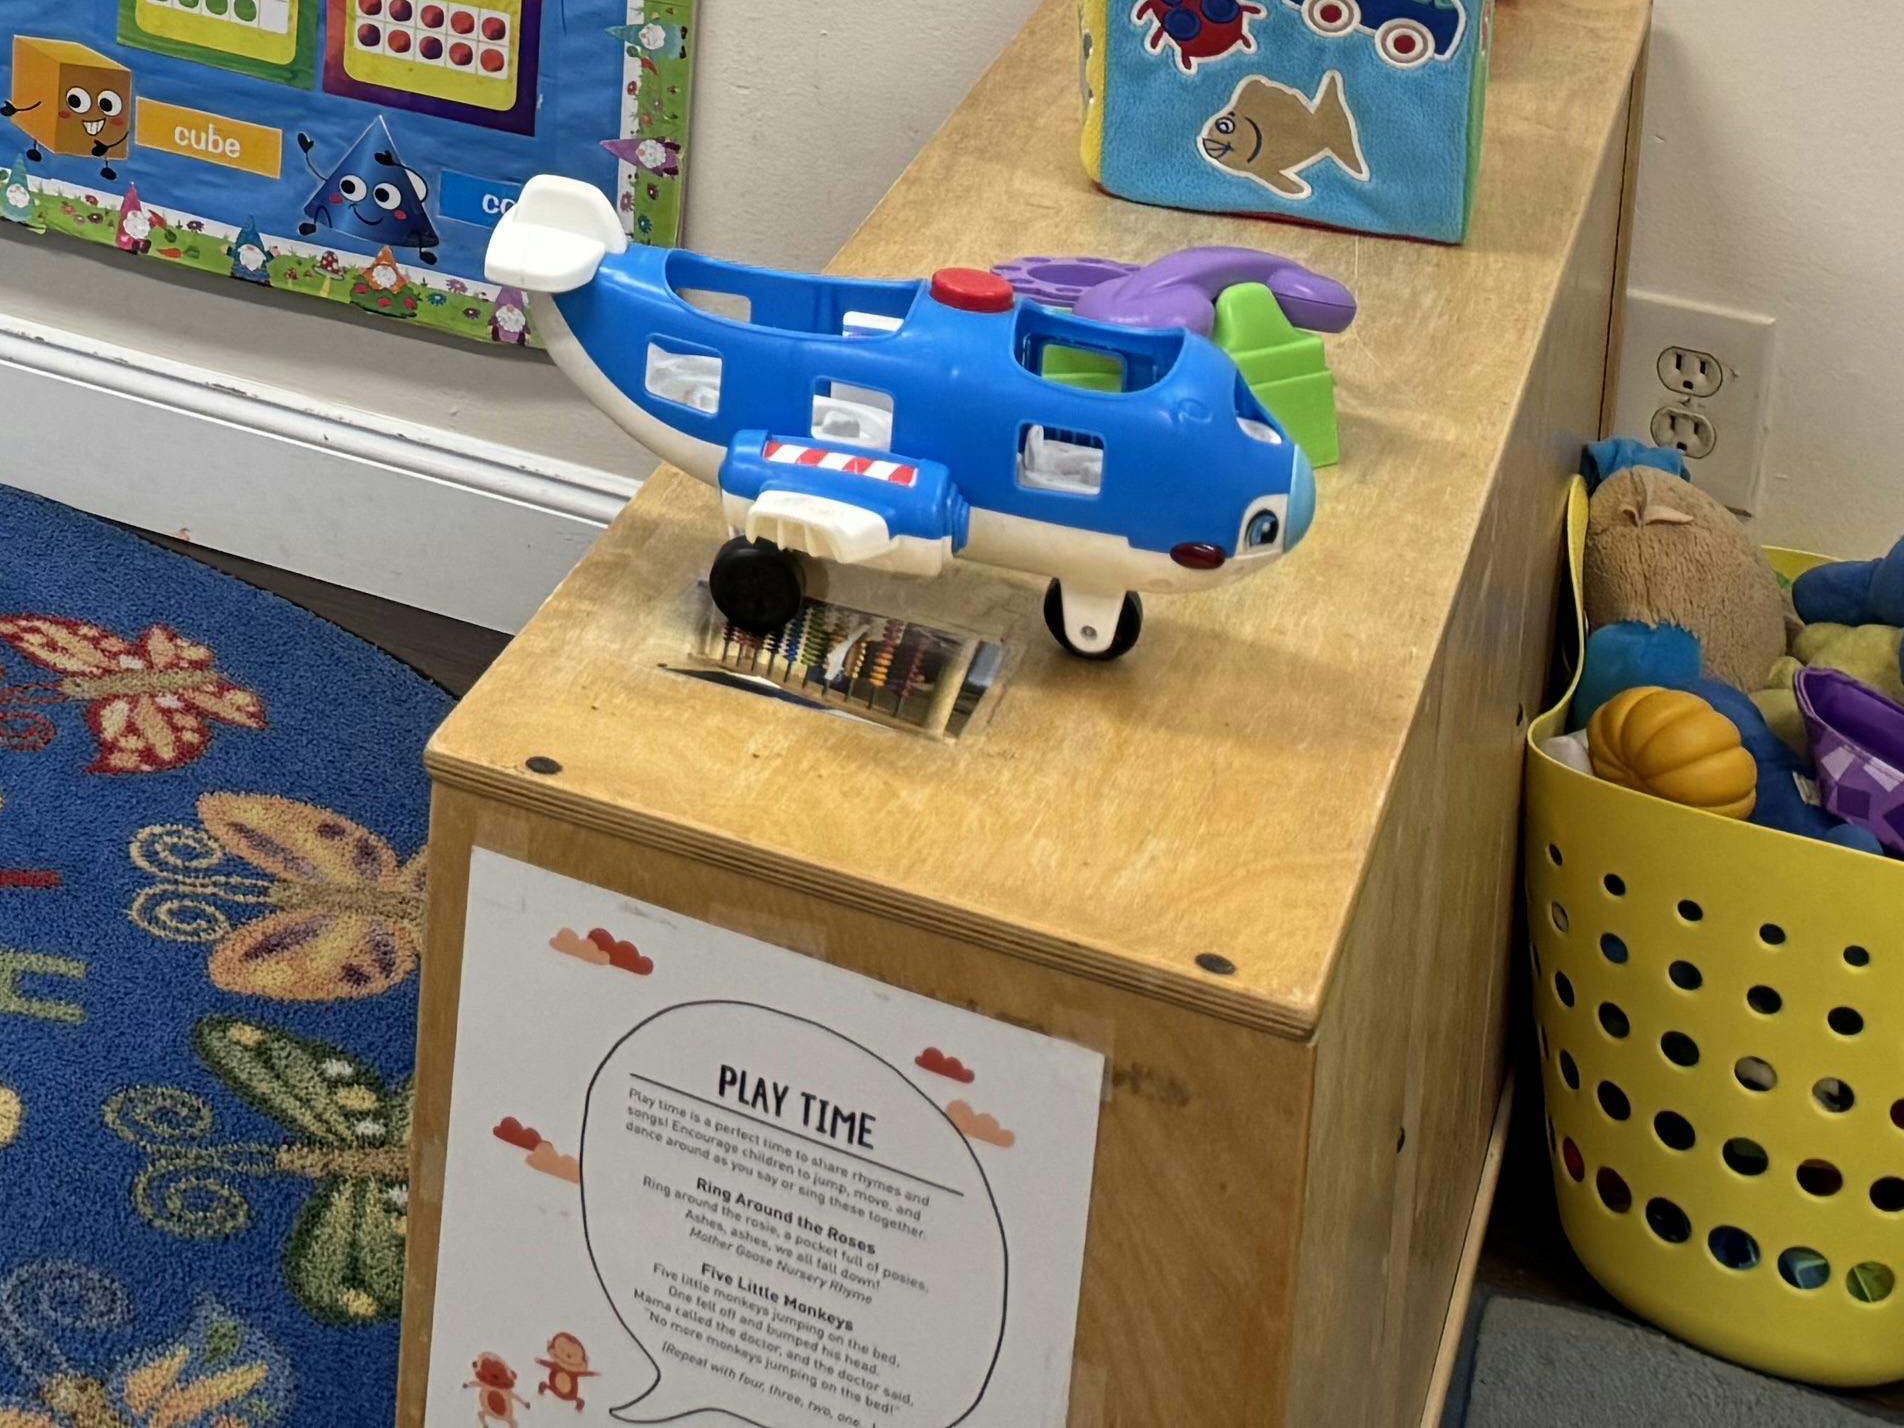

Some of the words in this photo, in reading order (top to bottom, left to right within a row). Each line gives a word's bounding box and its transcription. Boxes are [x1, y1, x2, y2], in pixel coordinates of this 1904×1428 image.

[174, 124, 240, 158] cube
[718, 1064, 789, 1117] PLAY
[801, 1092, 876, 1150] TIME
[696, 1177, 731, 1202] Ring
[735, 1193, 793, 1224] Around
[797, 1214, 823, 1236] the
[828, 1227, 875, 1254] Roses
[702, 1262, 733, 1286] Five
[738, 1277, 779, 1303] Little
[784, 1293, 853, 1331] Monkeys
